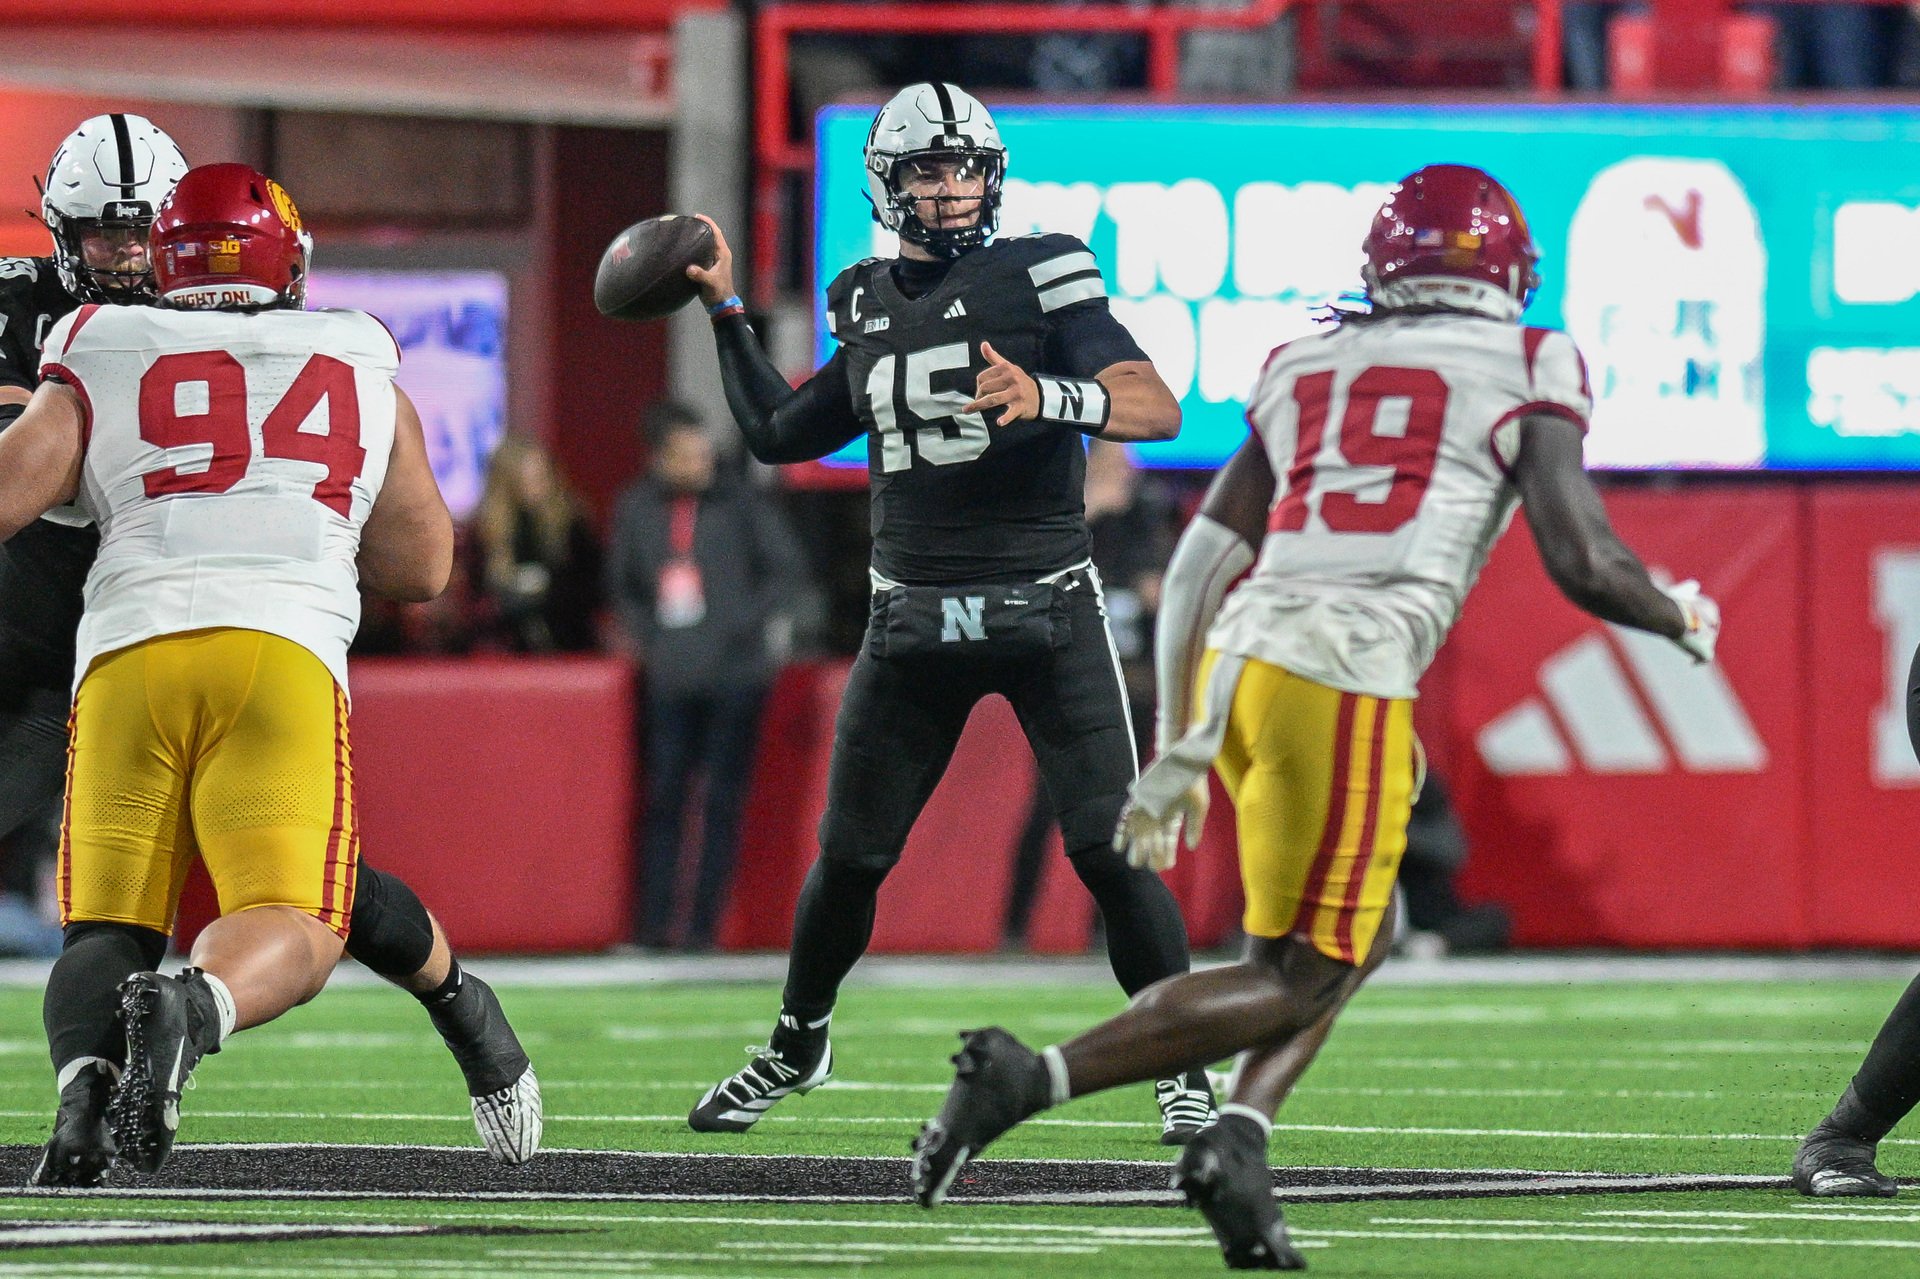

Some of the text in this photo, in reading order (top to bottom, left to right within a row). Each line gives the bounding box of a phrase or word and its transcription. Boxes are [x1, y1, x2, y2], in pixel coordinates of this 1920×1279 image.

[173, 290, 252, 307] FIGHT ON!
[854, 287, 864, 322] C
[139, 350, 367, 521] 94
[866, 342, 990, 472] 15
[1268, 366, 1449, 534] 19
[942, 596, 986, 642] N
